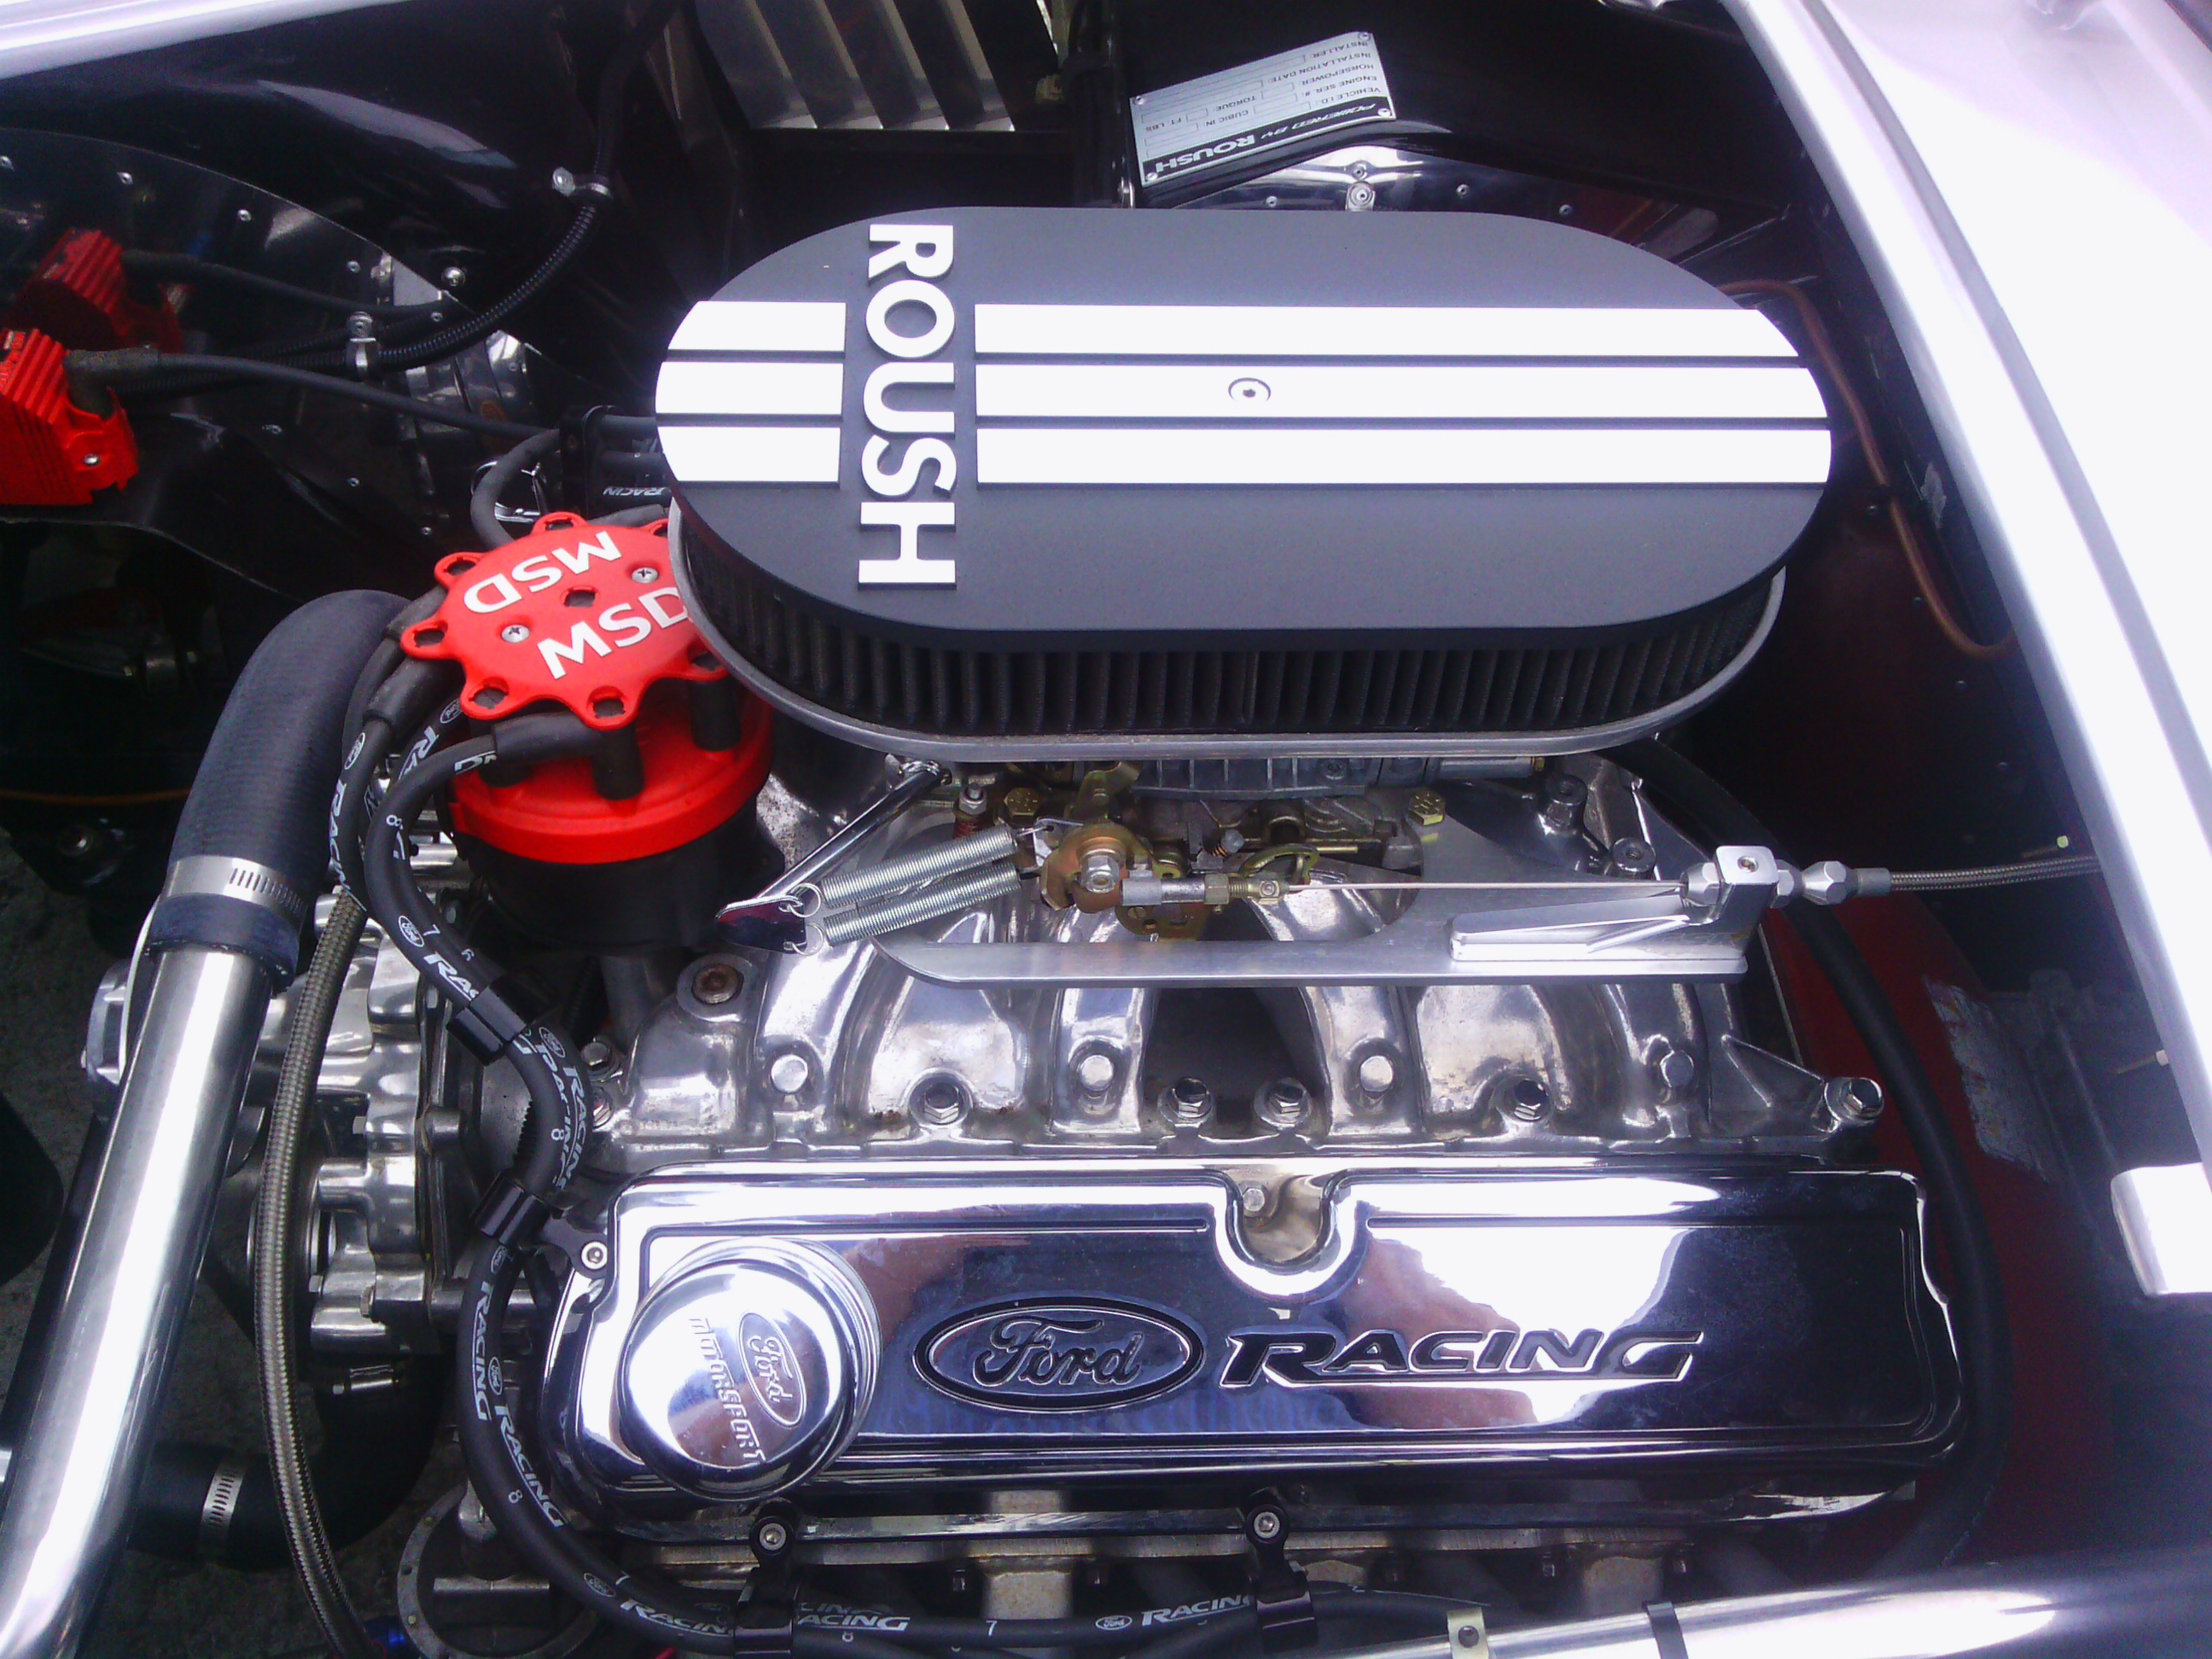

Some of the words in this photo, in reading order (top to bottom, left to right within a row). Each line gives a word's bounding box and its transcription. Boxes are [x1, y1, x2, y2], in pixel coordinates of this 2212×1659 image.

[1310, 39, 1369, 60] INSTALLER:
[1298, 52, 1371, 75] INSTALLATION
[1298, 63, 1375, 86] HORSEPOWER:
[1267, 70, 1297, 84] DATE:
[1338, 75, 1377, 90] ENGINE
[1211, 96, 1256, 112] TORQUE:
[1336, 86, 1382, 101] VEHICLE
[1218, 110, 1250, 124] CUBIC
[1291, 102, 1377, 130] POWERED
[1260, 125, 1289, 140] BY
[1155, 134, 1256, 172] ROUSH
[859, 224, 958, 587] ROUSH
[602, 486, 667, 496] RACIN
[463, 530, 622, 614] MSD
[537, 586, 689, 680] MSD
[329, 778, 367, 911] RACIN
[422, 924, 440, 937] 7
[550, 1128, 565, 1141] 8
[472, 1281, 494, 1420] RACING
[973, 1314, 1144, 1387] Ford
[1220, 1329, 1704, 1388] RACING
[747, 1336, 794, 1404] Ford
[689, 1318, 767, 1464] MOTORSPORT
[494, 1404, 570, 1528] RACING
[508, 1489, 523, 1505] 8
[620, 1598, 734, 1637] RACIN
[798, 1615, 911, 1631] ACING
[986, 1620, 998, 1637] 7
[1098, 1615, 1128, 1630] Ford
